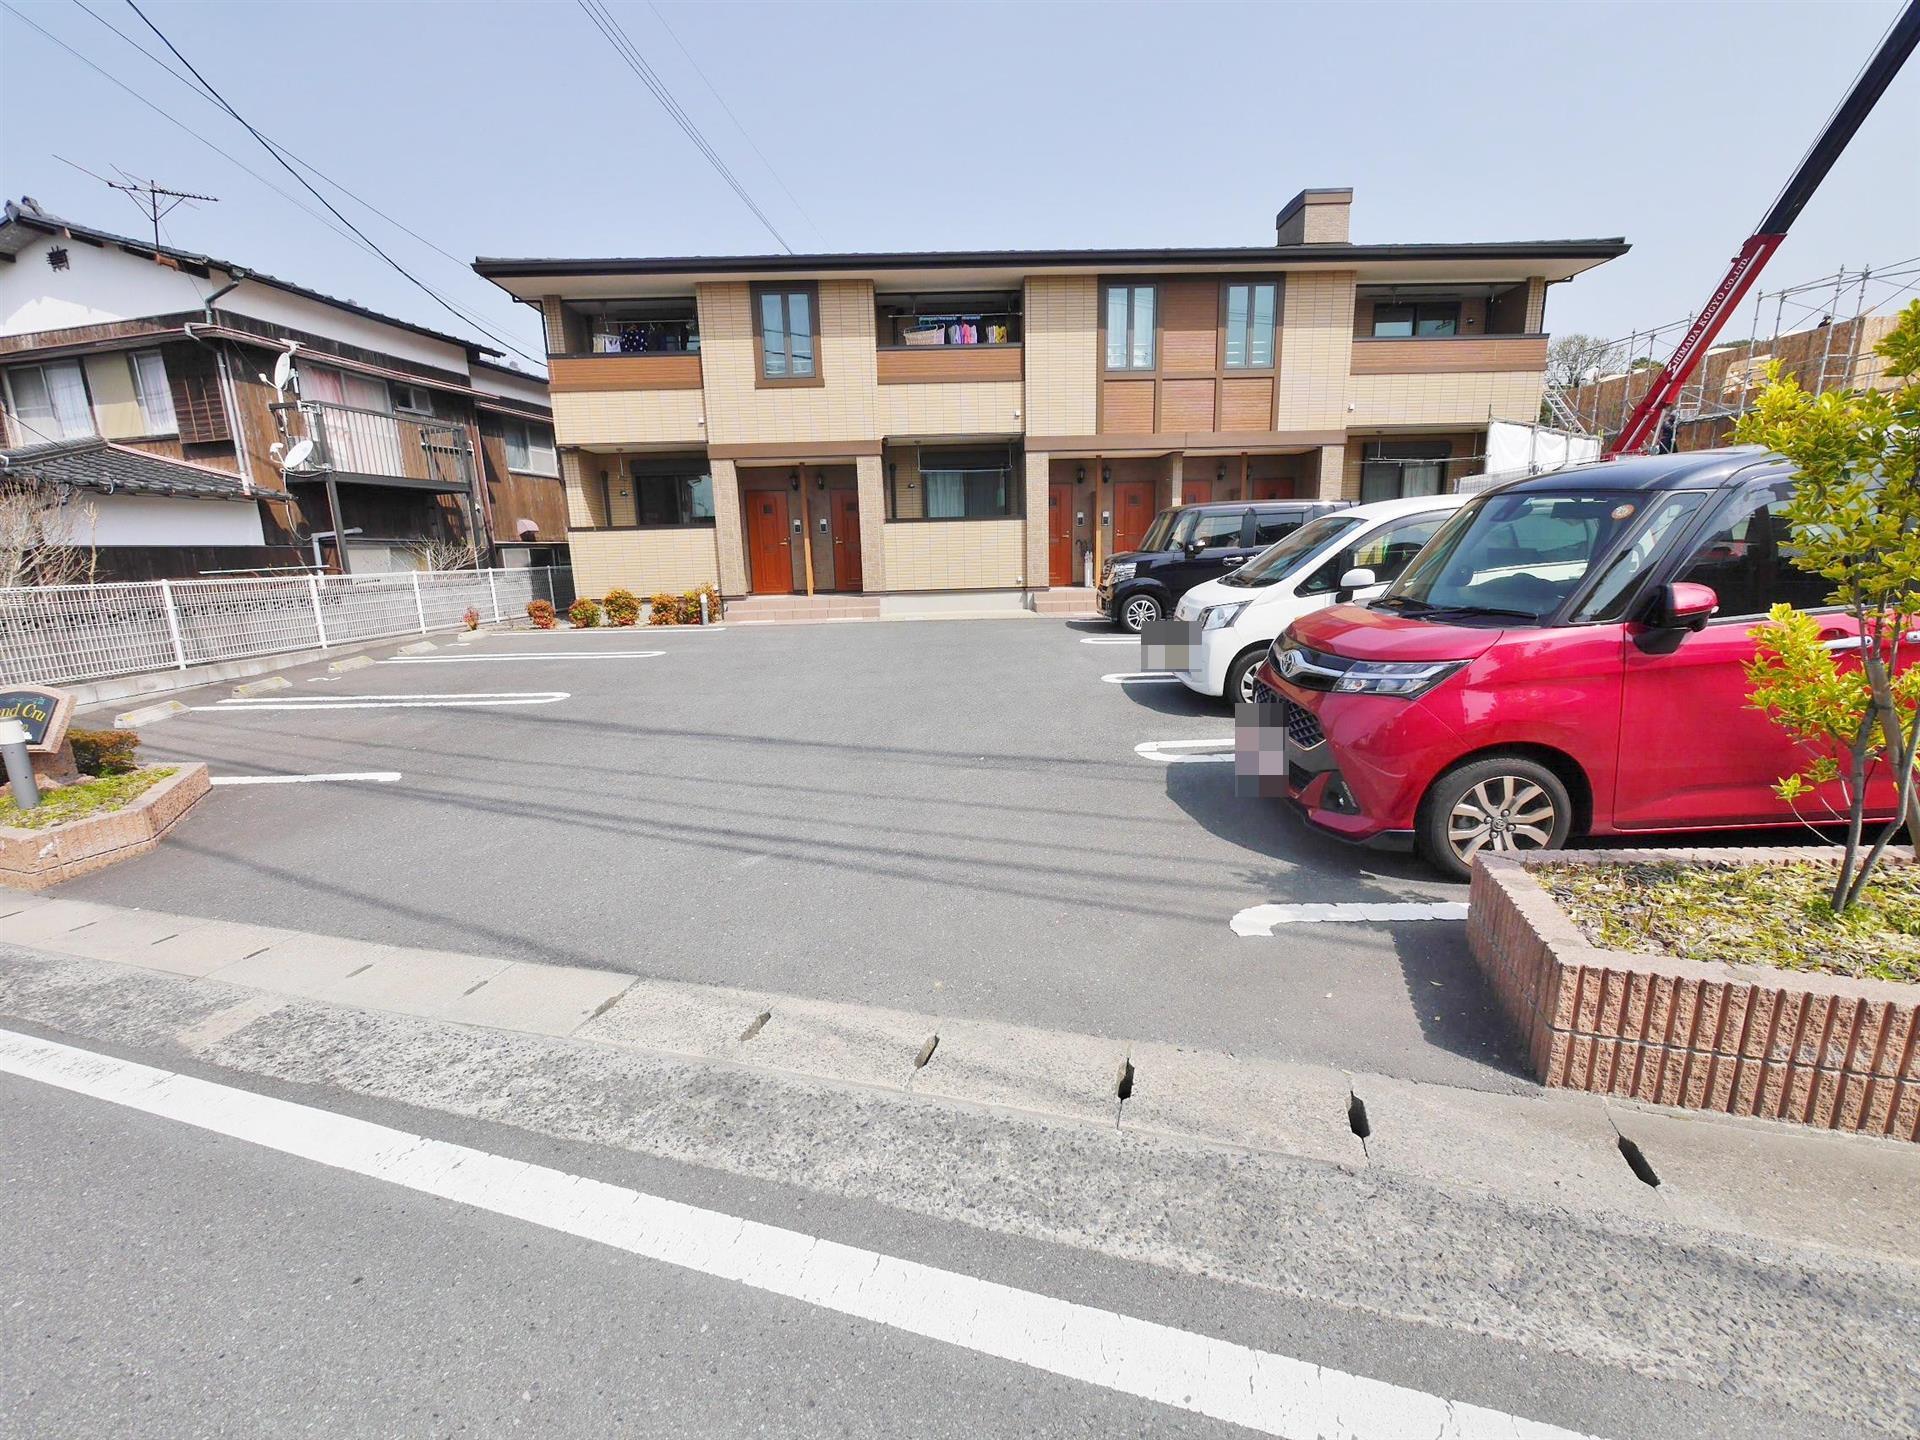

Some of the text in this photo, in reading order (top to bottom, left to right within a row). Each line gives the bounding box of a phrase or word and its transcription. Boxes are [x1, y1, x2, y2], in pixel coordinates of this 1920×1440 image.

[1667, 330, 1701, 373] SHIMADA
[1698, 292, 1725, 327] KOGYO
[0, 703, 46, 722] nd Cru
